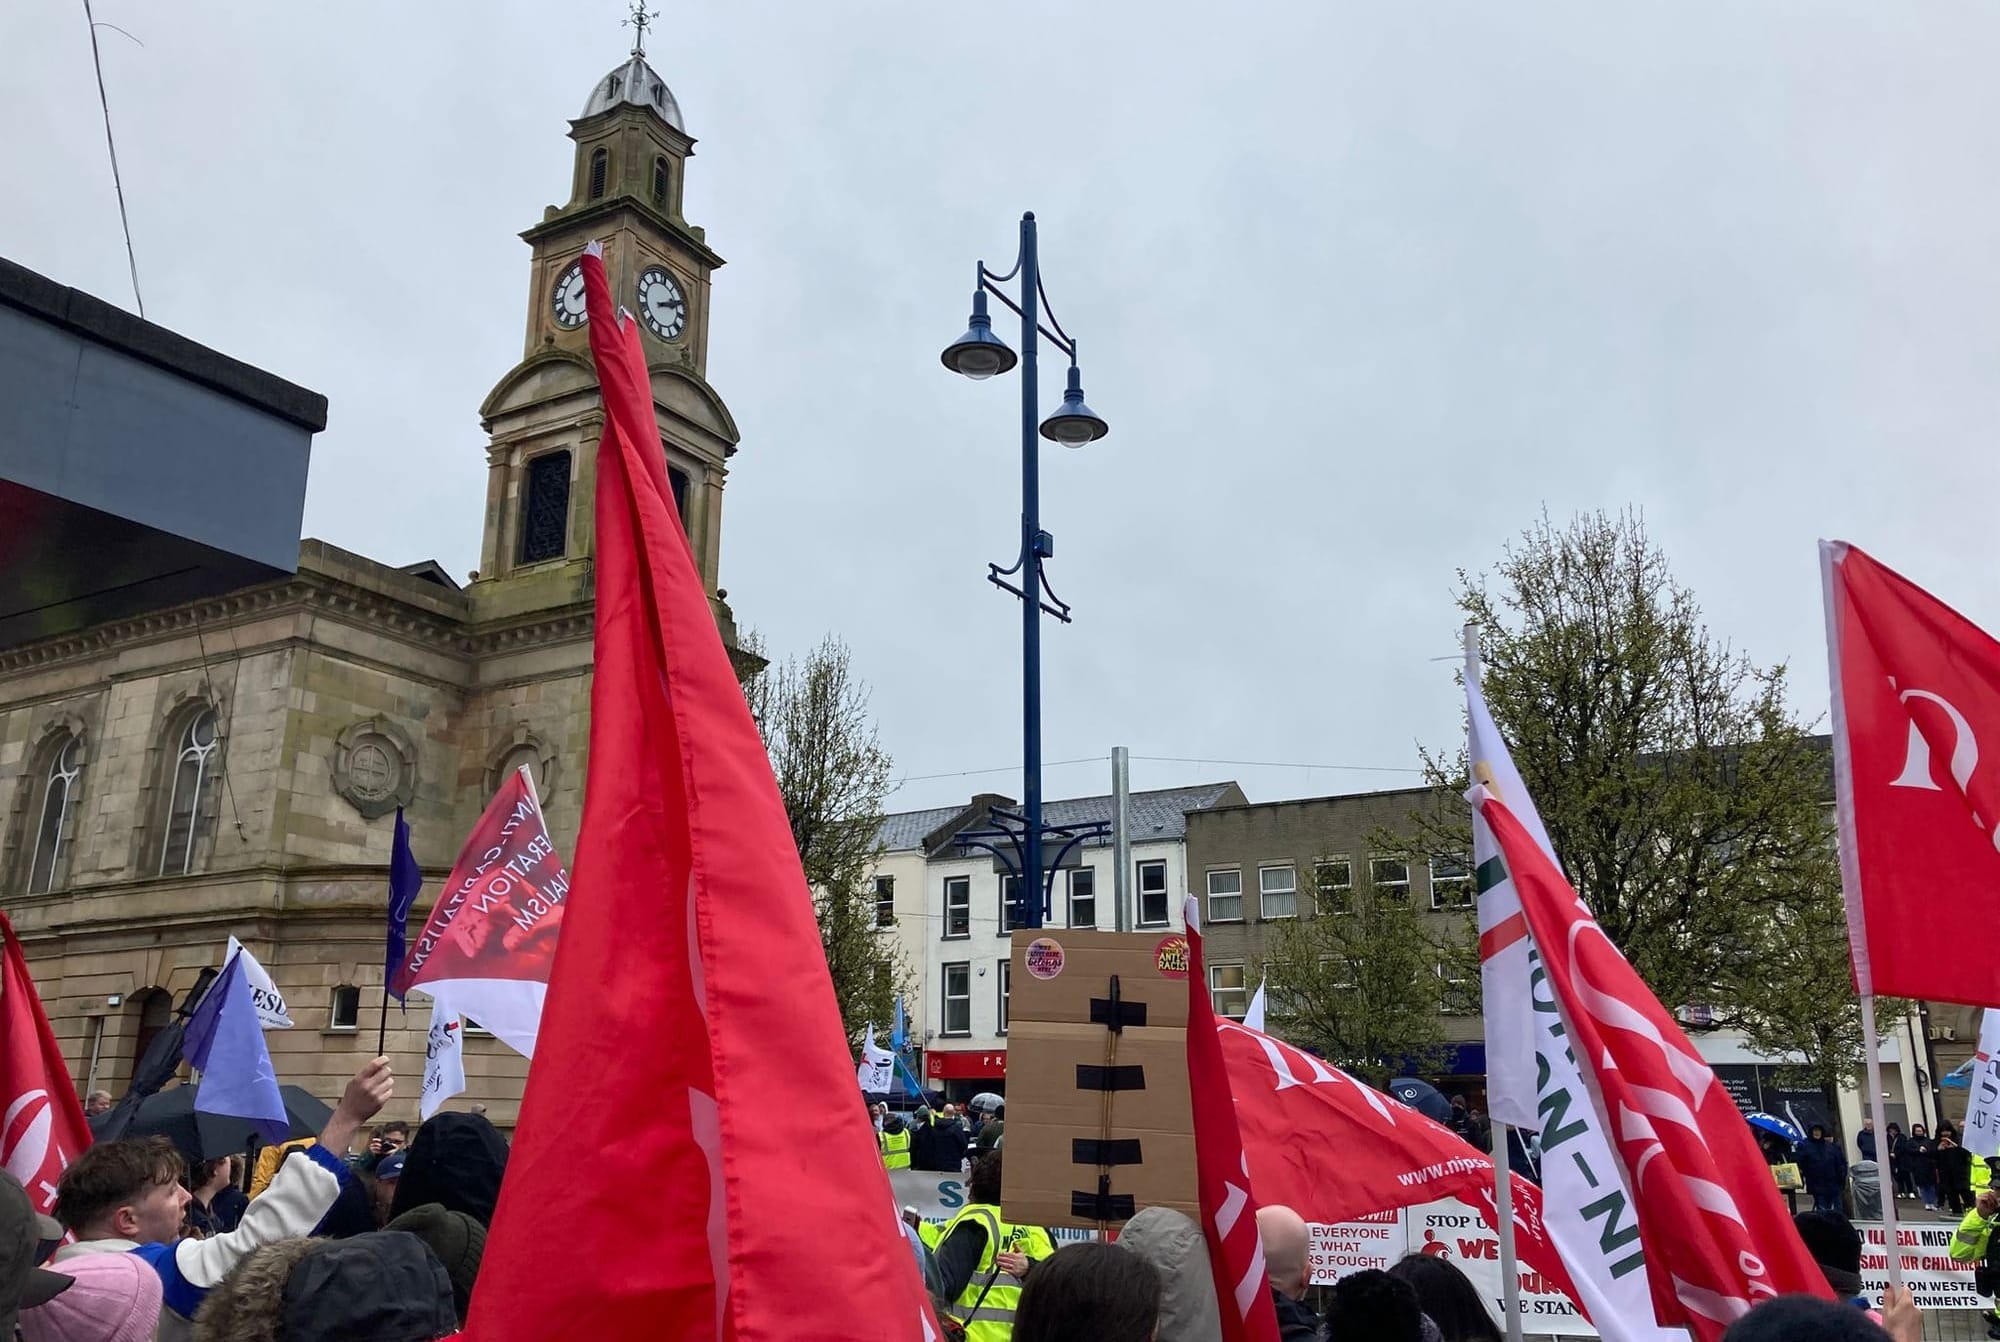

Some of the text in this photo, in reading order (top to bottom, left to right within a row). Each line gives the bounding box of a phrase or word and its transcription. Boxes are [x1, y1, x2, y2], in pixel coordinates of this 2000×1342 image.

[1425, 1214, 1470, 1229] STOP
[1312, 1226, 1390, 1240] EVERYONE
[1867, 1229, 1920, 1247] ILLGAL
[1320, 1241, 1361, 1252] WHAT
[1328, 1255, 1387, 1267] FOUGHT
[1907, 1281, 1927, 1292] ON
[1876, 1295, 1979, 1307] GRNMENTS
